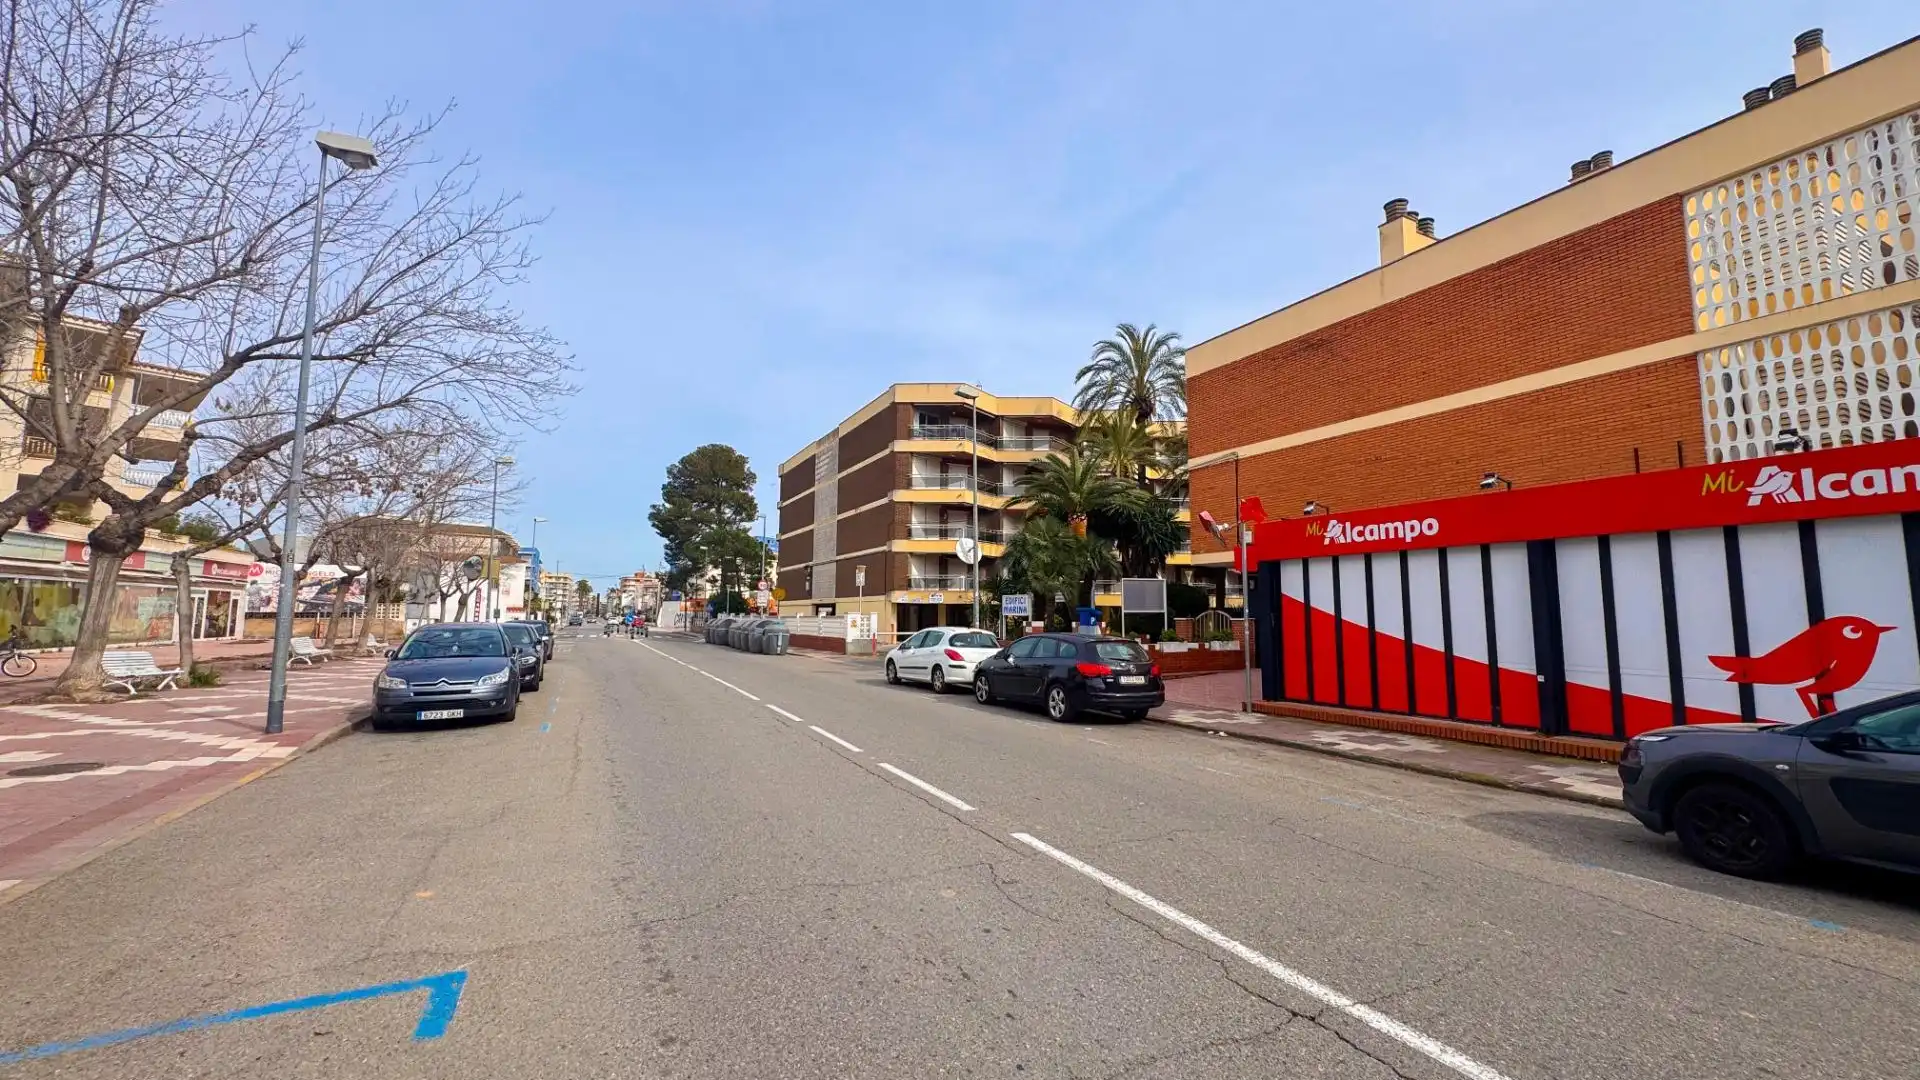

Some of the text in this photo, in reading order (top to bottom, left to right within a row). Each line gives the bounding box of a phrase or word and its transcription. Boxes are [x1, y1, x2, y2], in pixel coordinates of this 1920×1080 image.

[1701, 469, 1744, 496] Mi
[1305, 517, 1439, 545] Mi Alcampo
[1005, 596, 1027, 605] EDIFICI
[1003, 606, 1028, 614] MARINA
